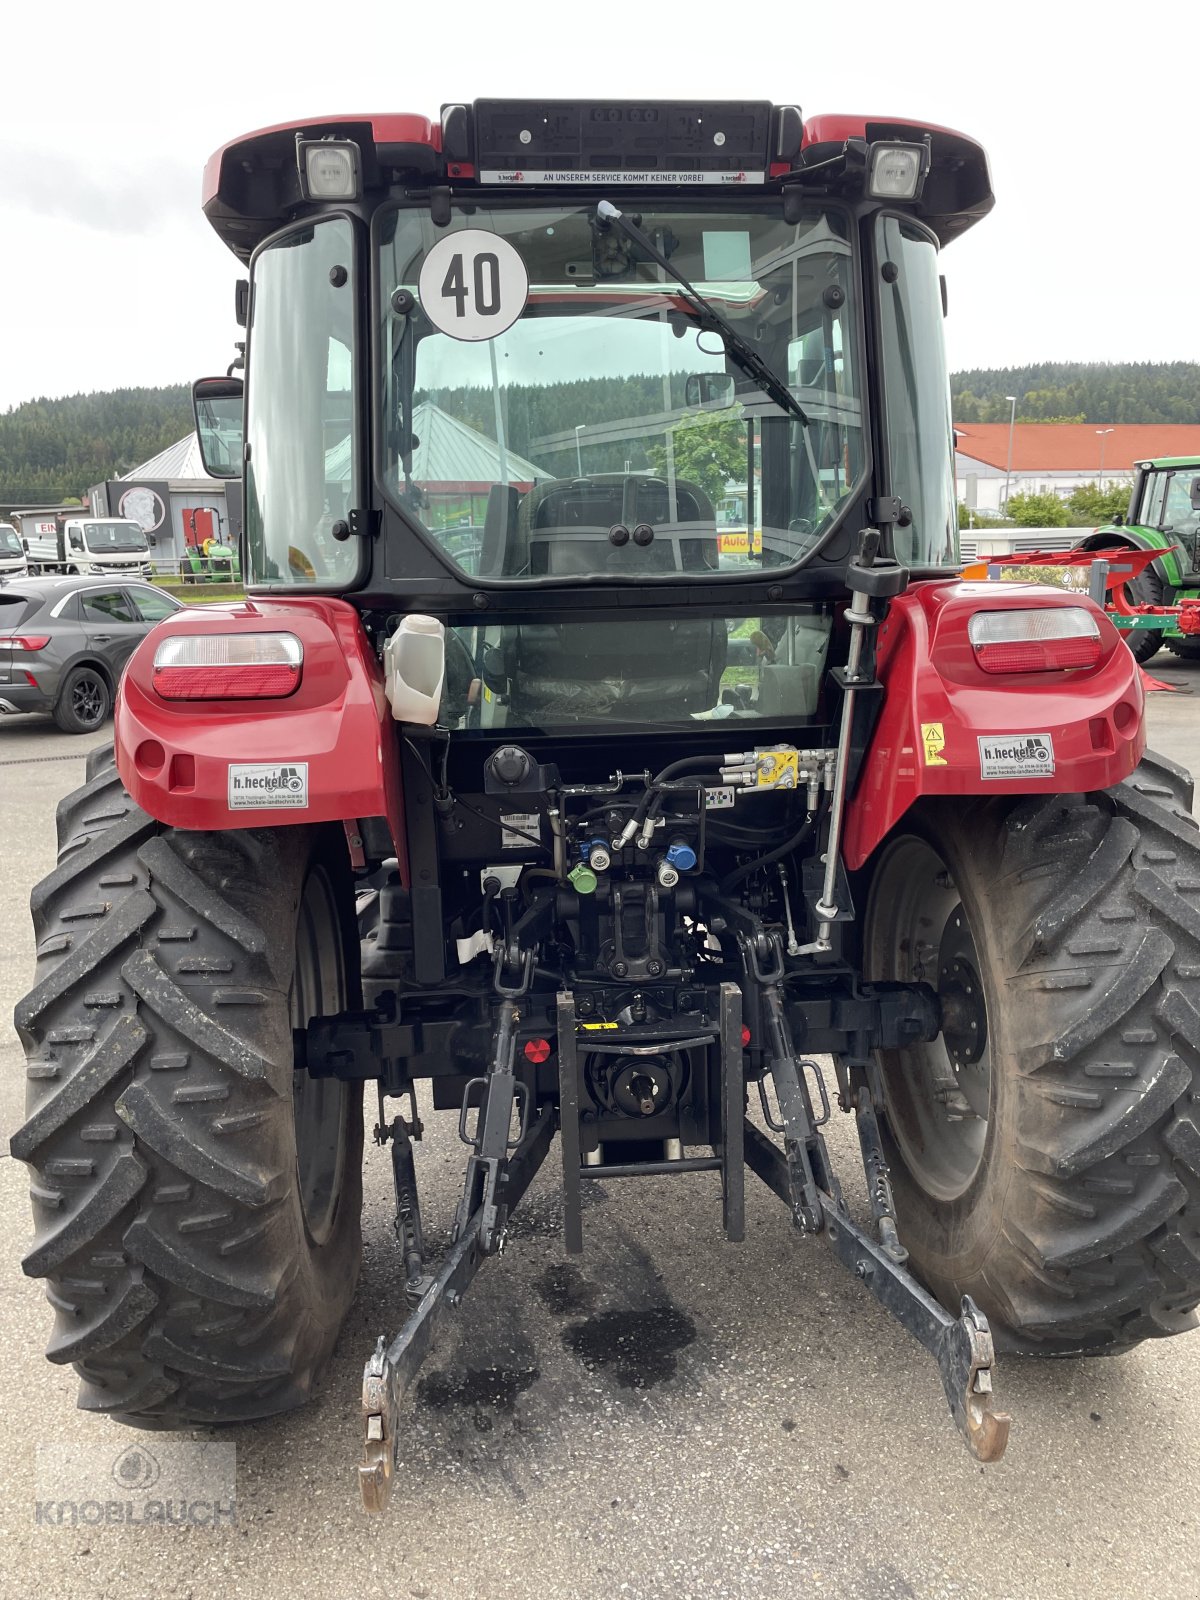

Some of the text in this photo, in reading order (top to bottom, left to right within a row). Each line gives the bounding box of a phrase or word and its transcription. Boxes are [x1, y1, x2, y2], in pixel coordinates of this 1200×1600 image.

[543, 173, 704, 182] AN UNSEREM SERVICE KOMMT KEINER VORBEI
[441, 252, 501, 318] 40
[984, 747, 1036, 760] h.heckele
[233, 775, 289, 789] h.heckele
